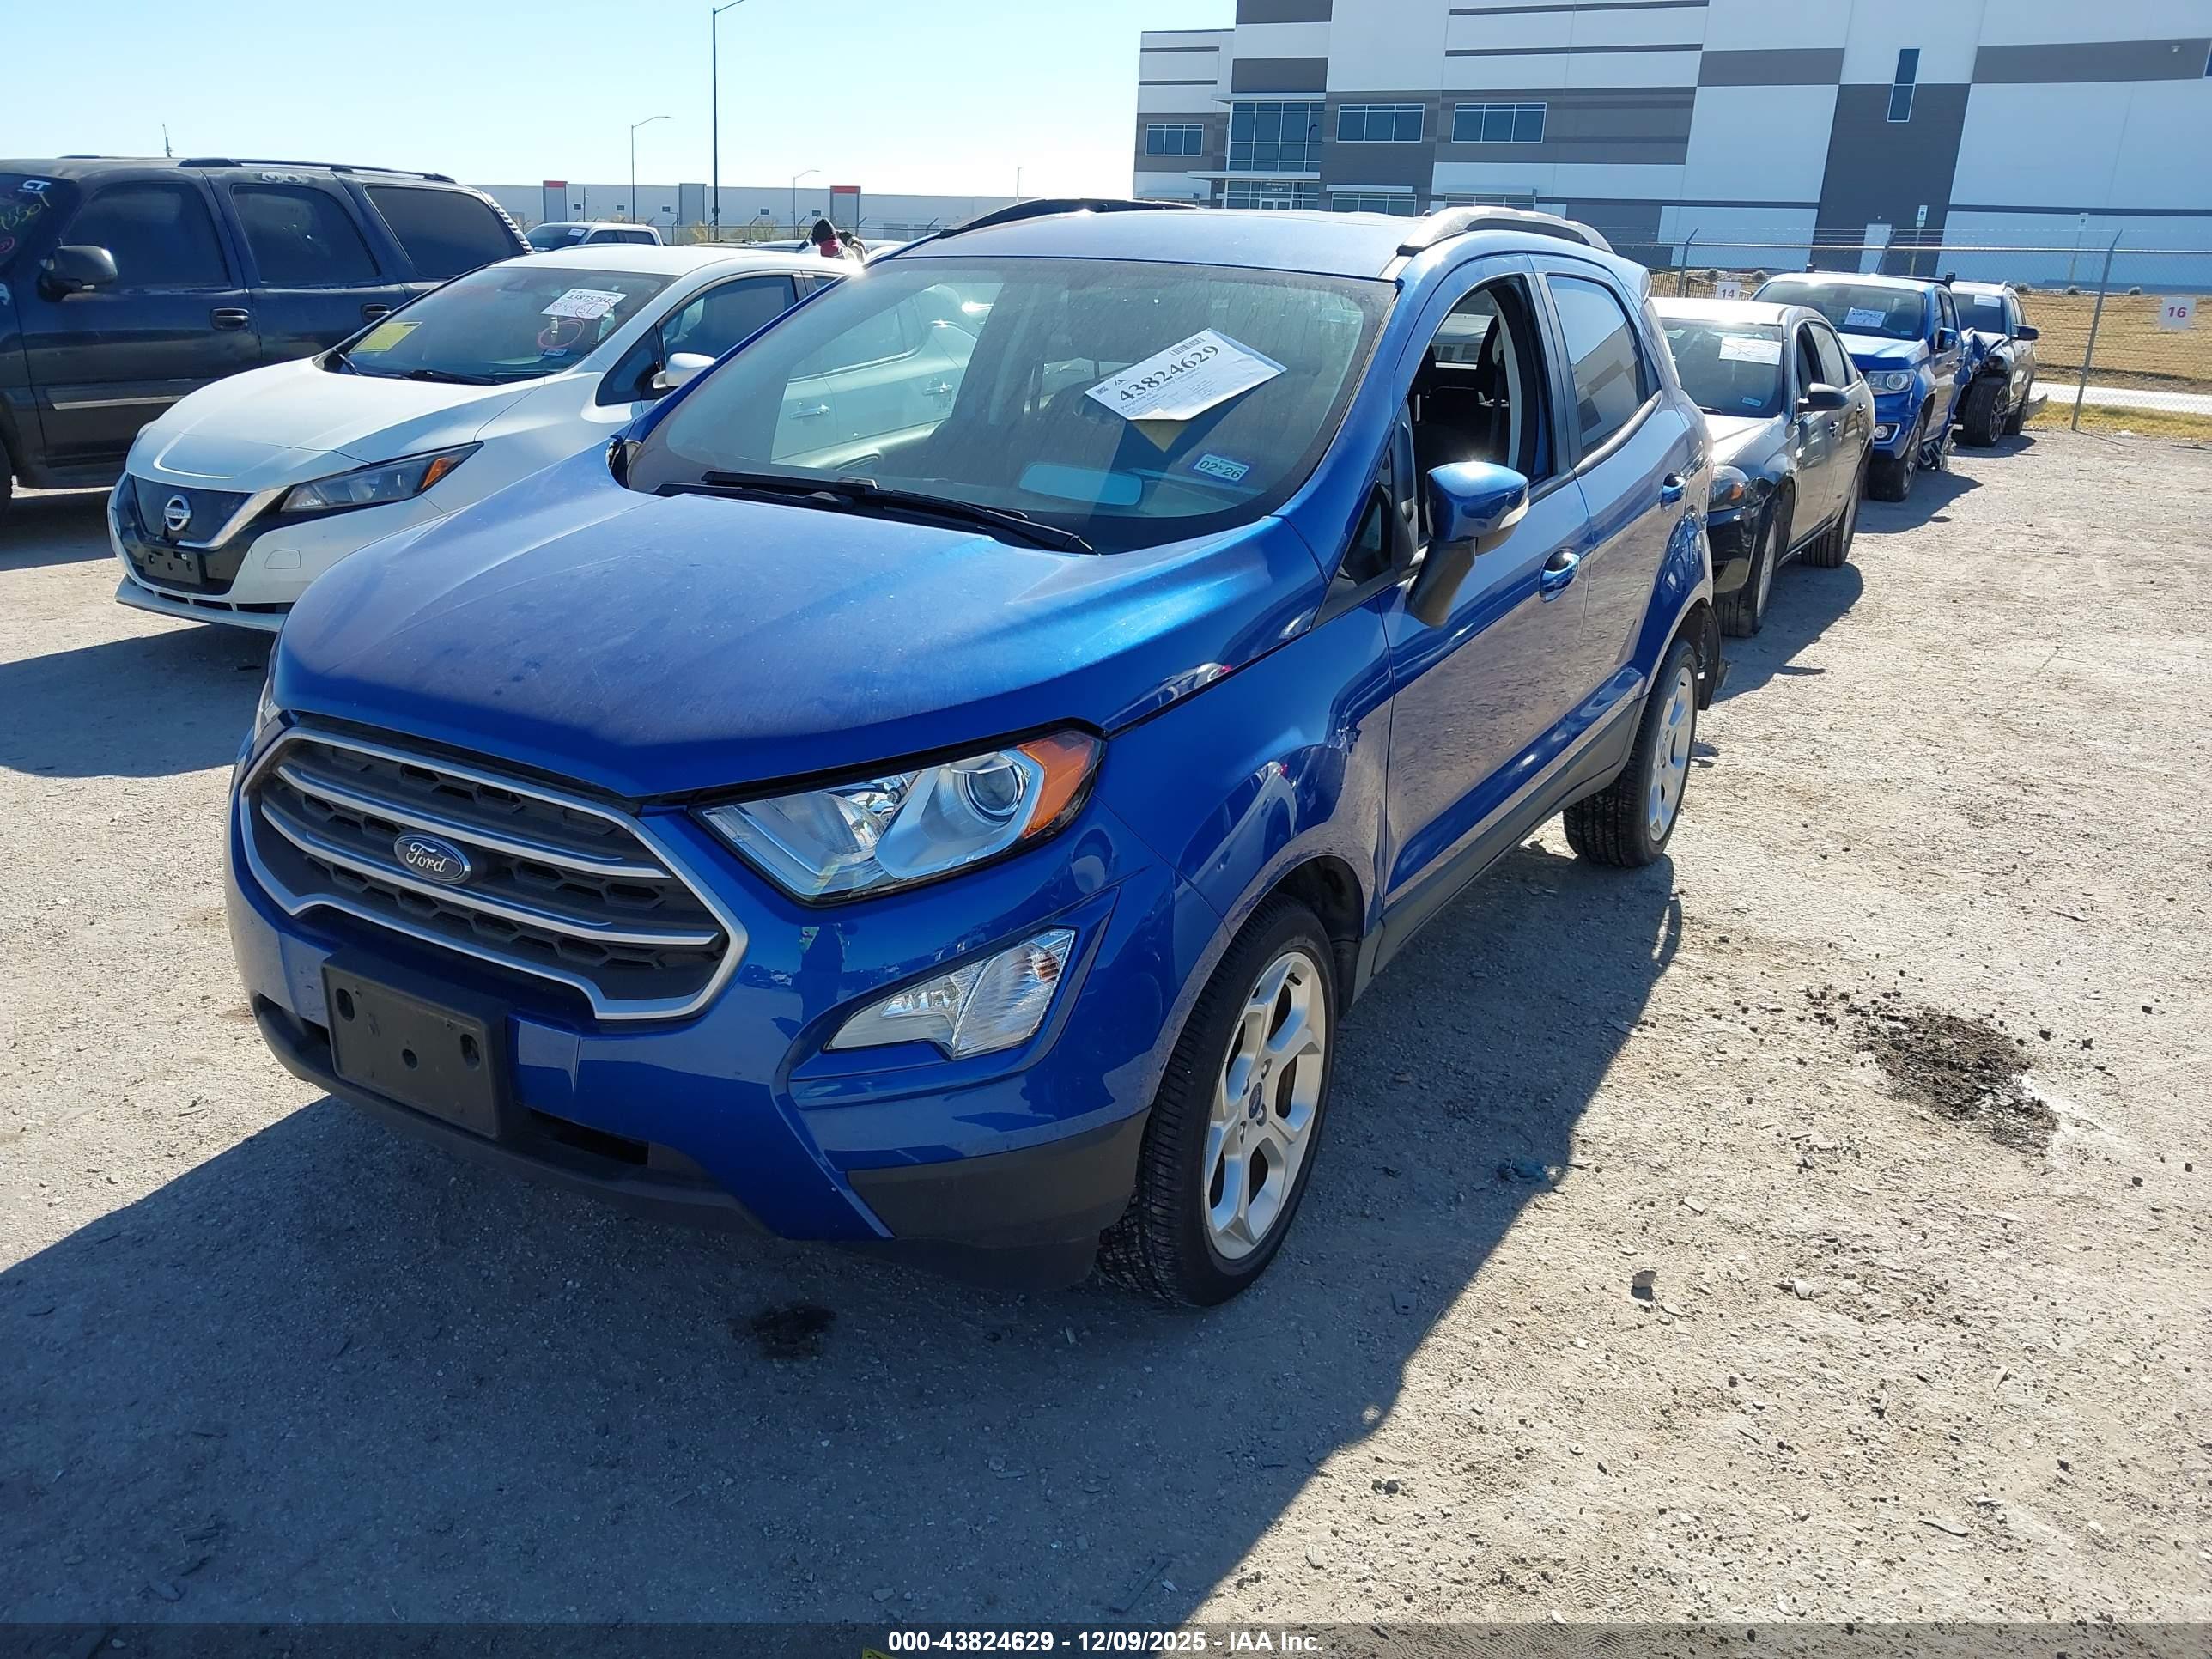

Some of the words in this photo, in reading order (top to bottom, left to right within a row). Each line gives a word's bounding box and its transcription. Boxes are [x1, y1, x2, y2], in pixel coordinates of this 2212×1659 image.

[1721, 289, 1735, 299] 14
[2167, 306, 2187, 318] 16
[1120, 345, 1219, 402] 43824629
[1221, 466, 1243, 479] 26
[405, 842, 447, 873] Ford
